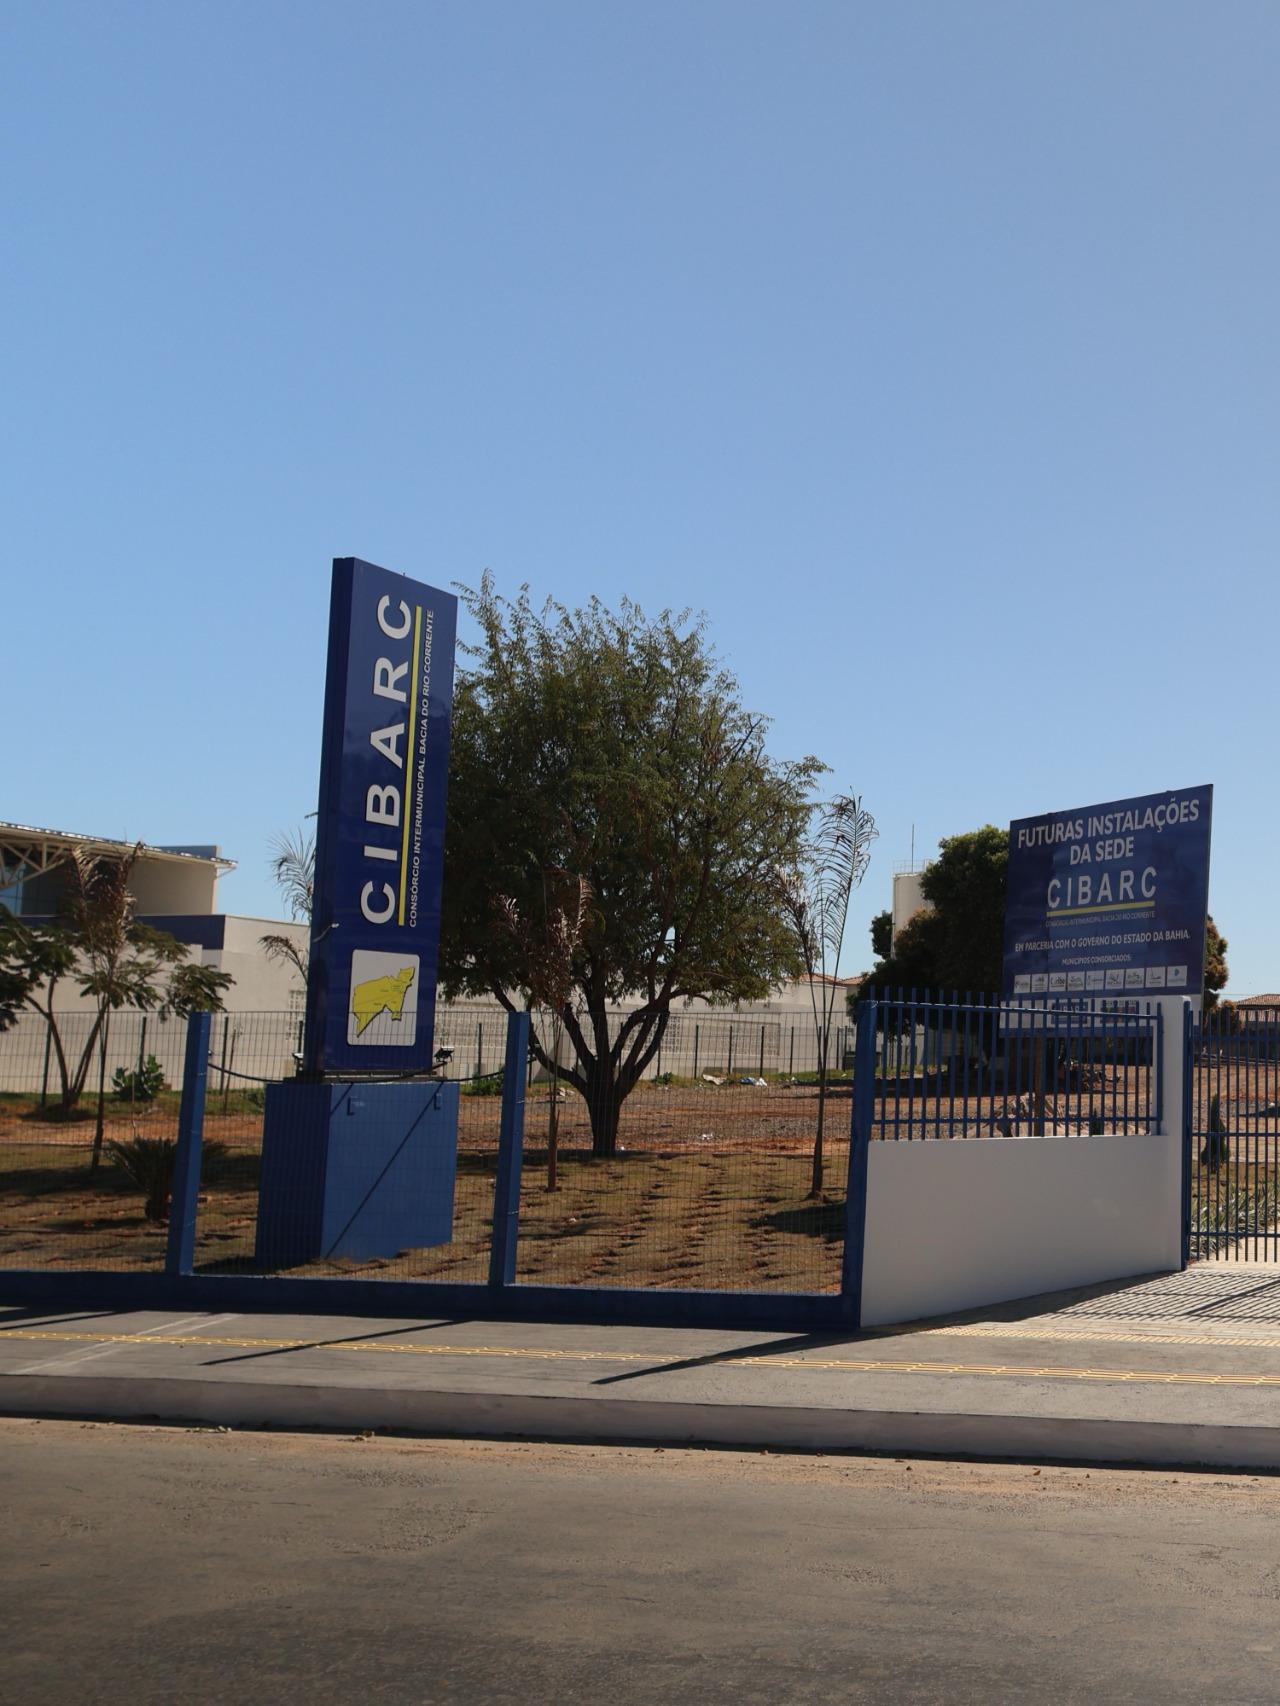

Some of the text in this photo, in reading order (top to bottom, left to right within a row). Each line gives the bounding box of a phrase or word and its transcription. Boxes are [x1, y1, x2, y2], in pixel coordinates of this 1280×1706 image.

[360, 594, 412, 925] CIBARC
[409, 609, 434, 928] CONSÓRCIO INTERMUNICIPAL BACIA DO RIO CORRENTE
[1018, 797, 1199, 848] FUTURAS INSTALAÇÕES
[1070, 837, 1134, 865] DA SEDE
[1047, 866, 1157, 908] CIBARC
[1015, 943, 1024, 952] EM
[1025, 941, 1053, 951] PARCERIA
[1054, 939, 1070, 949] COM
[1071, 938, 1077, 948] O
[1077, 936, 1110, 947] GOVERNO
[1111, 935, 1122, 944] DO
[1123, 932, 1152, 943] ESTADO
[1153, 930, 1164, 941] DA
